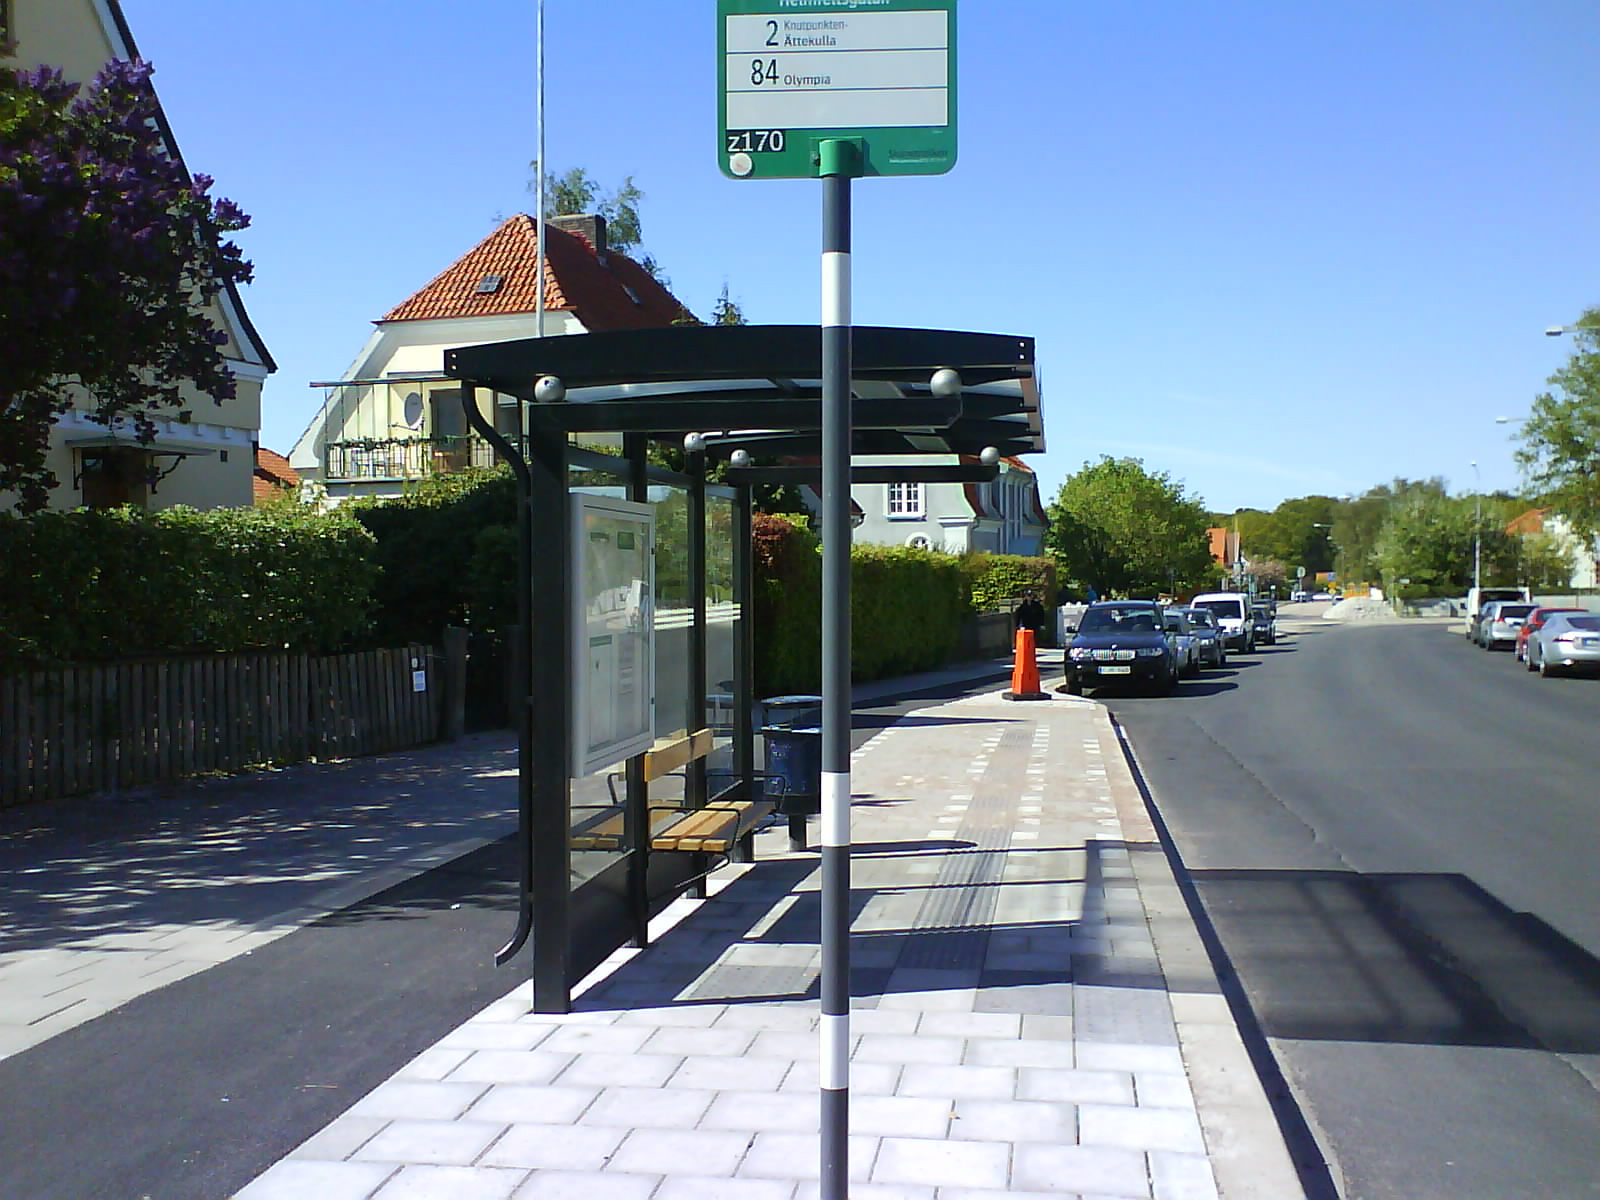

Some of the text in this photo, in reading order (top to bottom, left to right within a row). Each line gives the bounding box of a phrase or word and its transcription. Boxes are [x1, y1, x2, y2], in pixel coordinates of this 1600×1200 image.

[766, 20, 779, 46] 2
[784, 34, 836, 47] Ättekulla
[751, 58, 831, 87] 84 Olympia
[728, 131, 784, 151] z170
